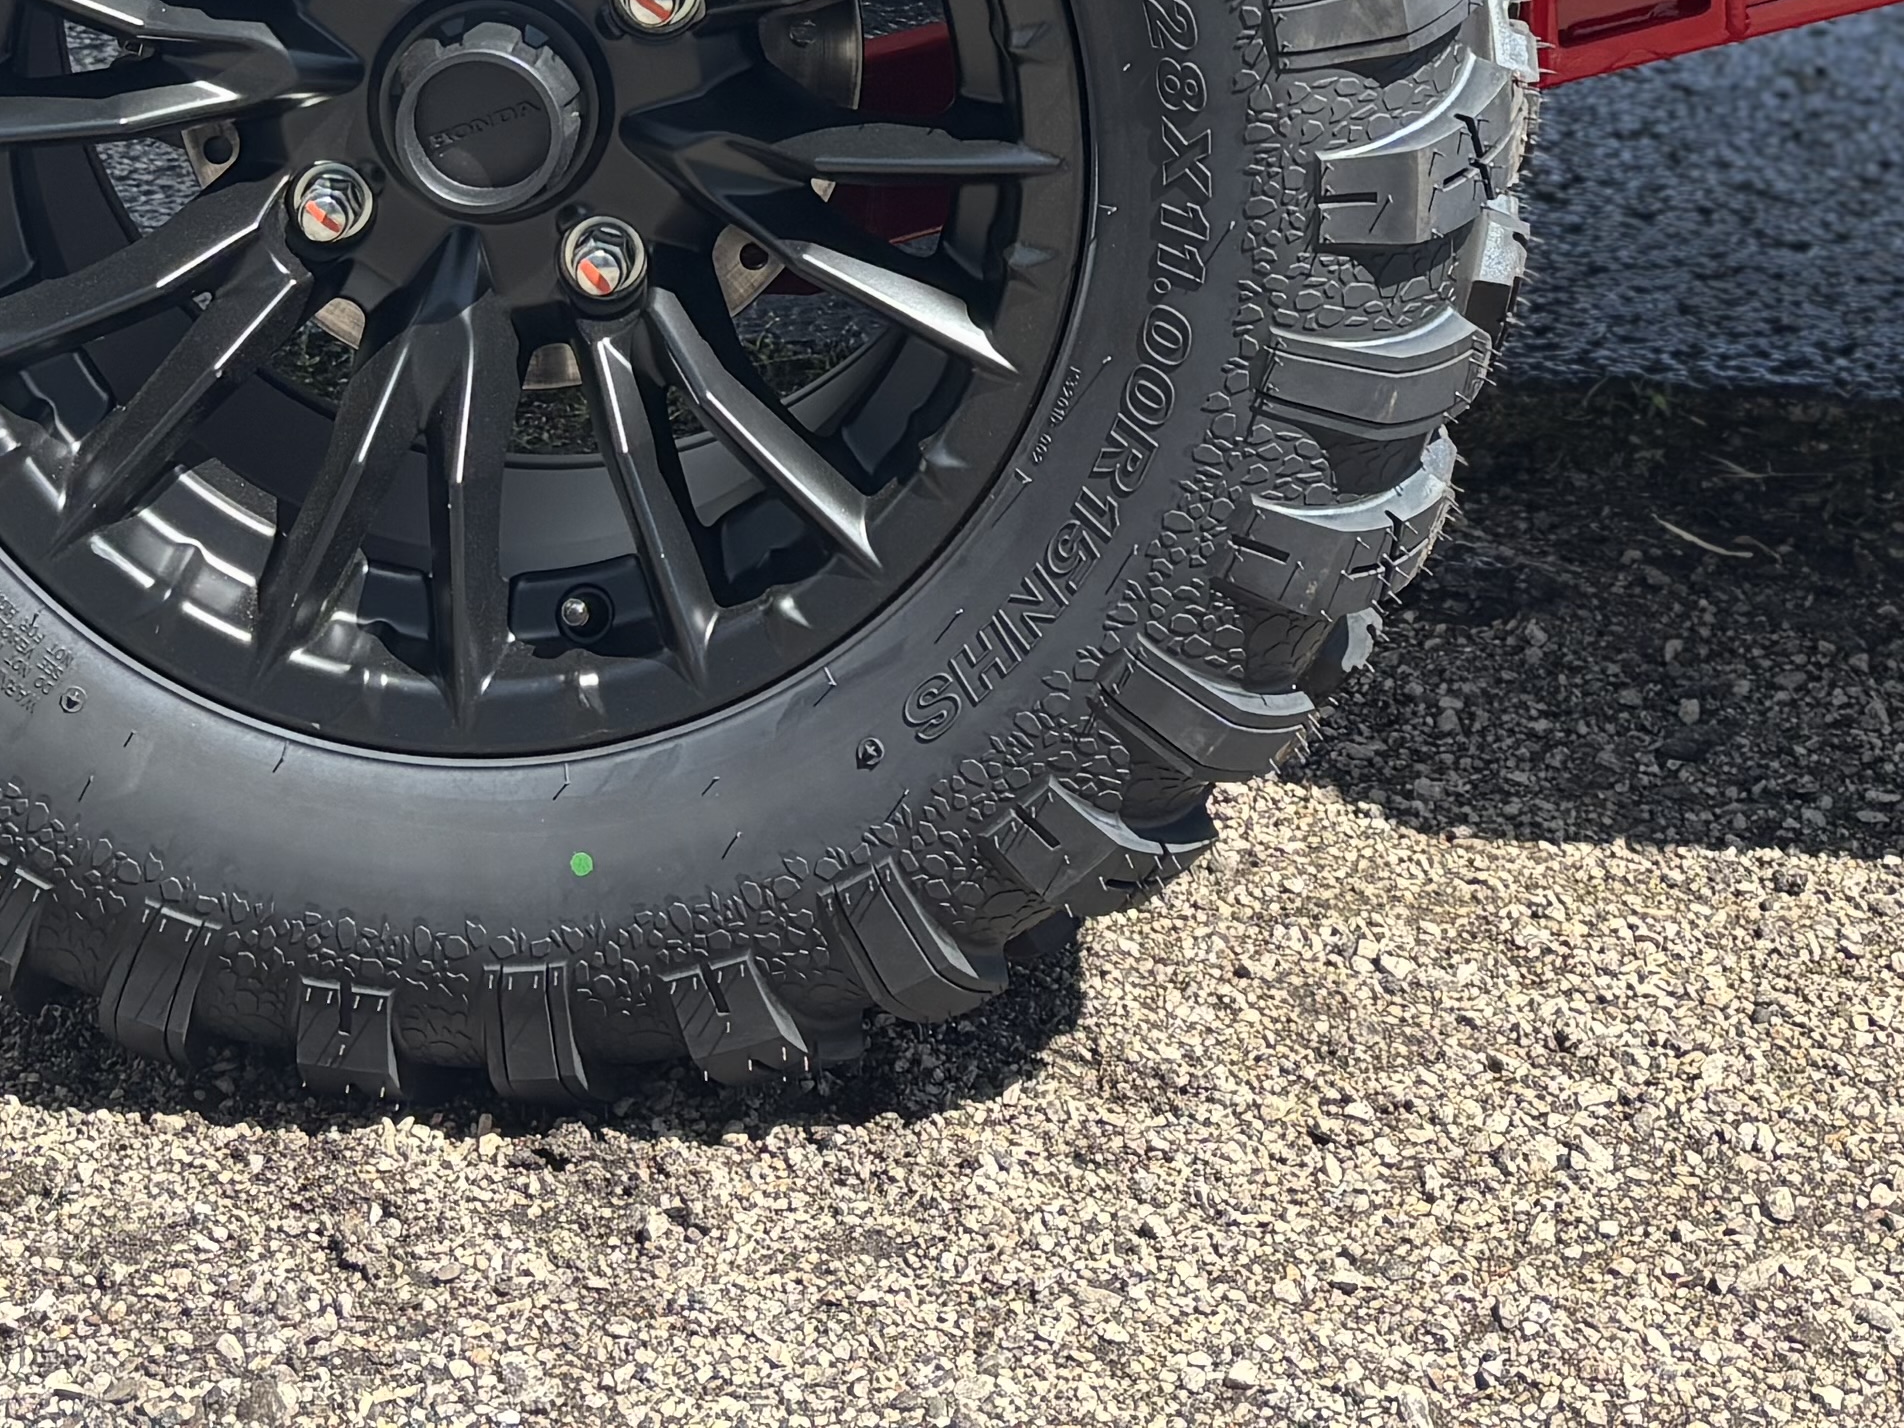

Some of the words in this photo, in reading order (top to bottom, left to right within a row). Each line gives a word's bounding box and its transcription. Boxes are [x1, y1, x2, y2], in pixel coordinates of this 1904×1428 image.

[428, 100, 542, 149] HONDA
[18, 620, 45, 644] FOR
[4, 651, 33, 679] NOT
[46, 639, 74, 669] NOT
[35, 655, 64, 682] SEE
[32, 674, 55, 696] DO
